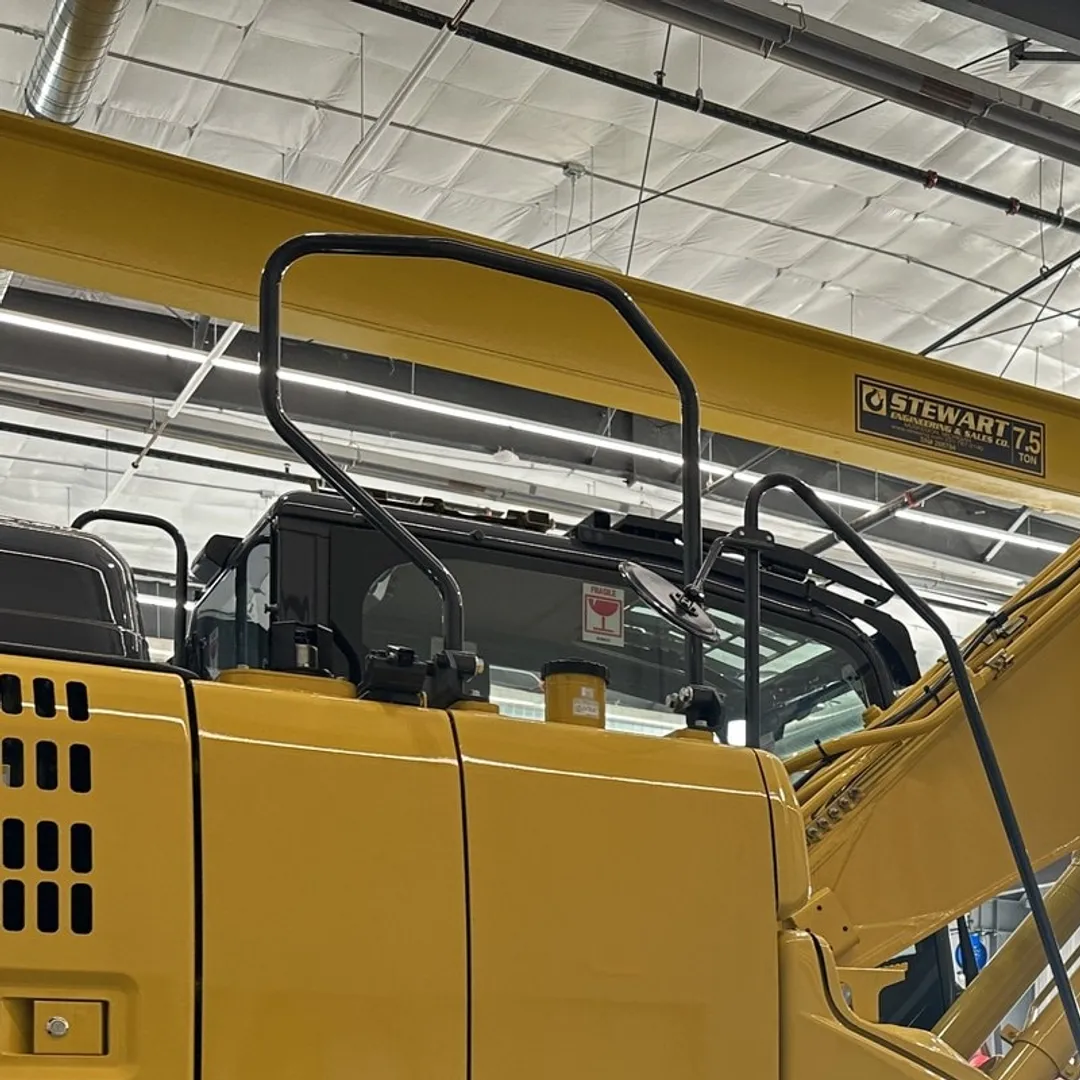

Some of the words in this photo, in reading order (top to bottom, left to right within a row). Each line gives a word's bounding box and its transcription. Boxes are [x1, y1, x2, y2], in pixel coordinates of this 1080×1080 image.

[889, 392, 1010, 438] STEWART
[890, 411, 951, 434] ENGINEERING
[953, 427, 961, 436] &
[964, 430, 993, 444] SALES
[1012, 426, 1042, 455] 7.5
[1018, 452, 1037, 466] TON
[590, 586, 616, 598] FRAGILE
